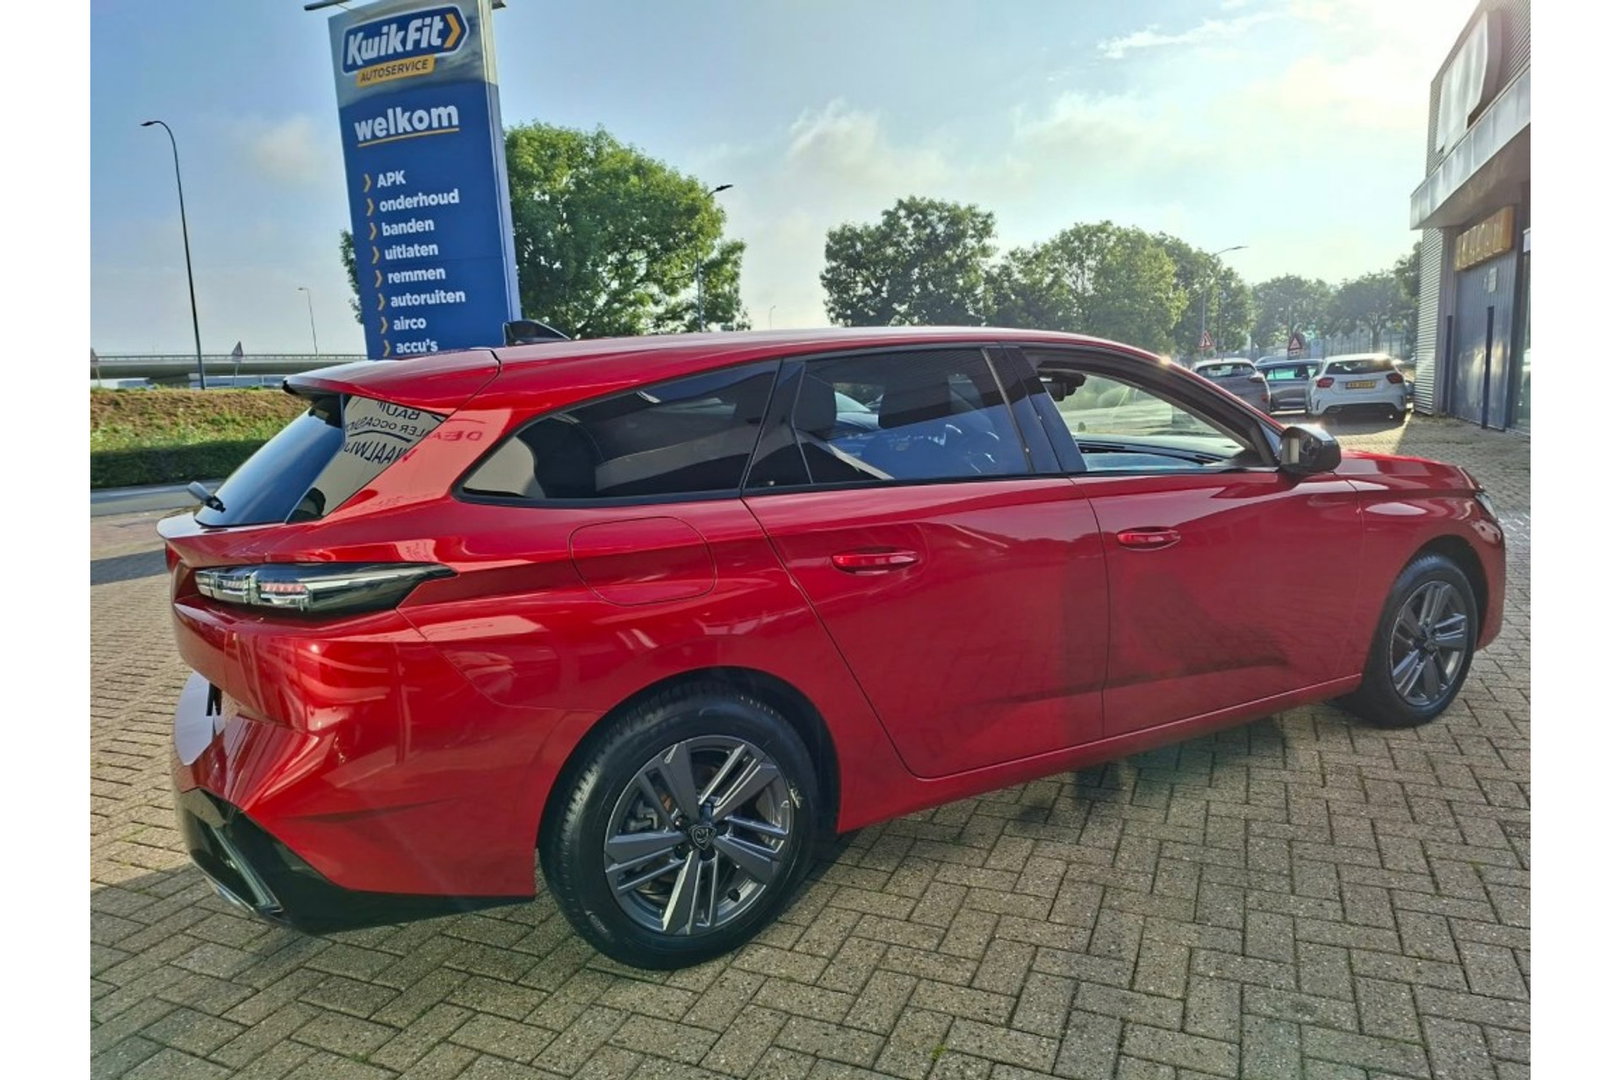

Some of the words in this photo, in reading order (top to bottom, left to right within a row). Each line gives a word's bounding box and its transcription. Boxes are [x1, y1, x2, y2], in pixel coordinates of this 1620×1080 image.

[360, 58, 430, 82] AUTOSERVICE
[354, 104, 459, 142] welkom
[377, 170, 406, 188] APK
[379, 188, 460, 212] onderhoud
[381, 218, 435, 236] banden
[384, 243, 439, 260] uitlaten
[387, 267, 446, 284] remmen
[390, 289, 466, 308] autoruiten
[393, 316, 427, 331] airco
[396, 338, 438, 354] accu's
